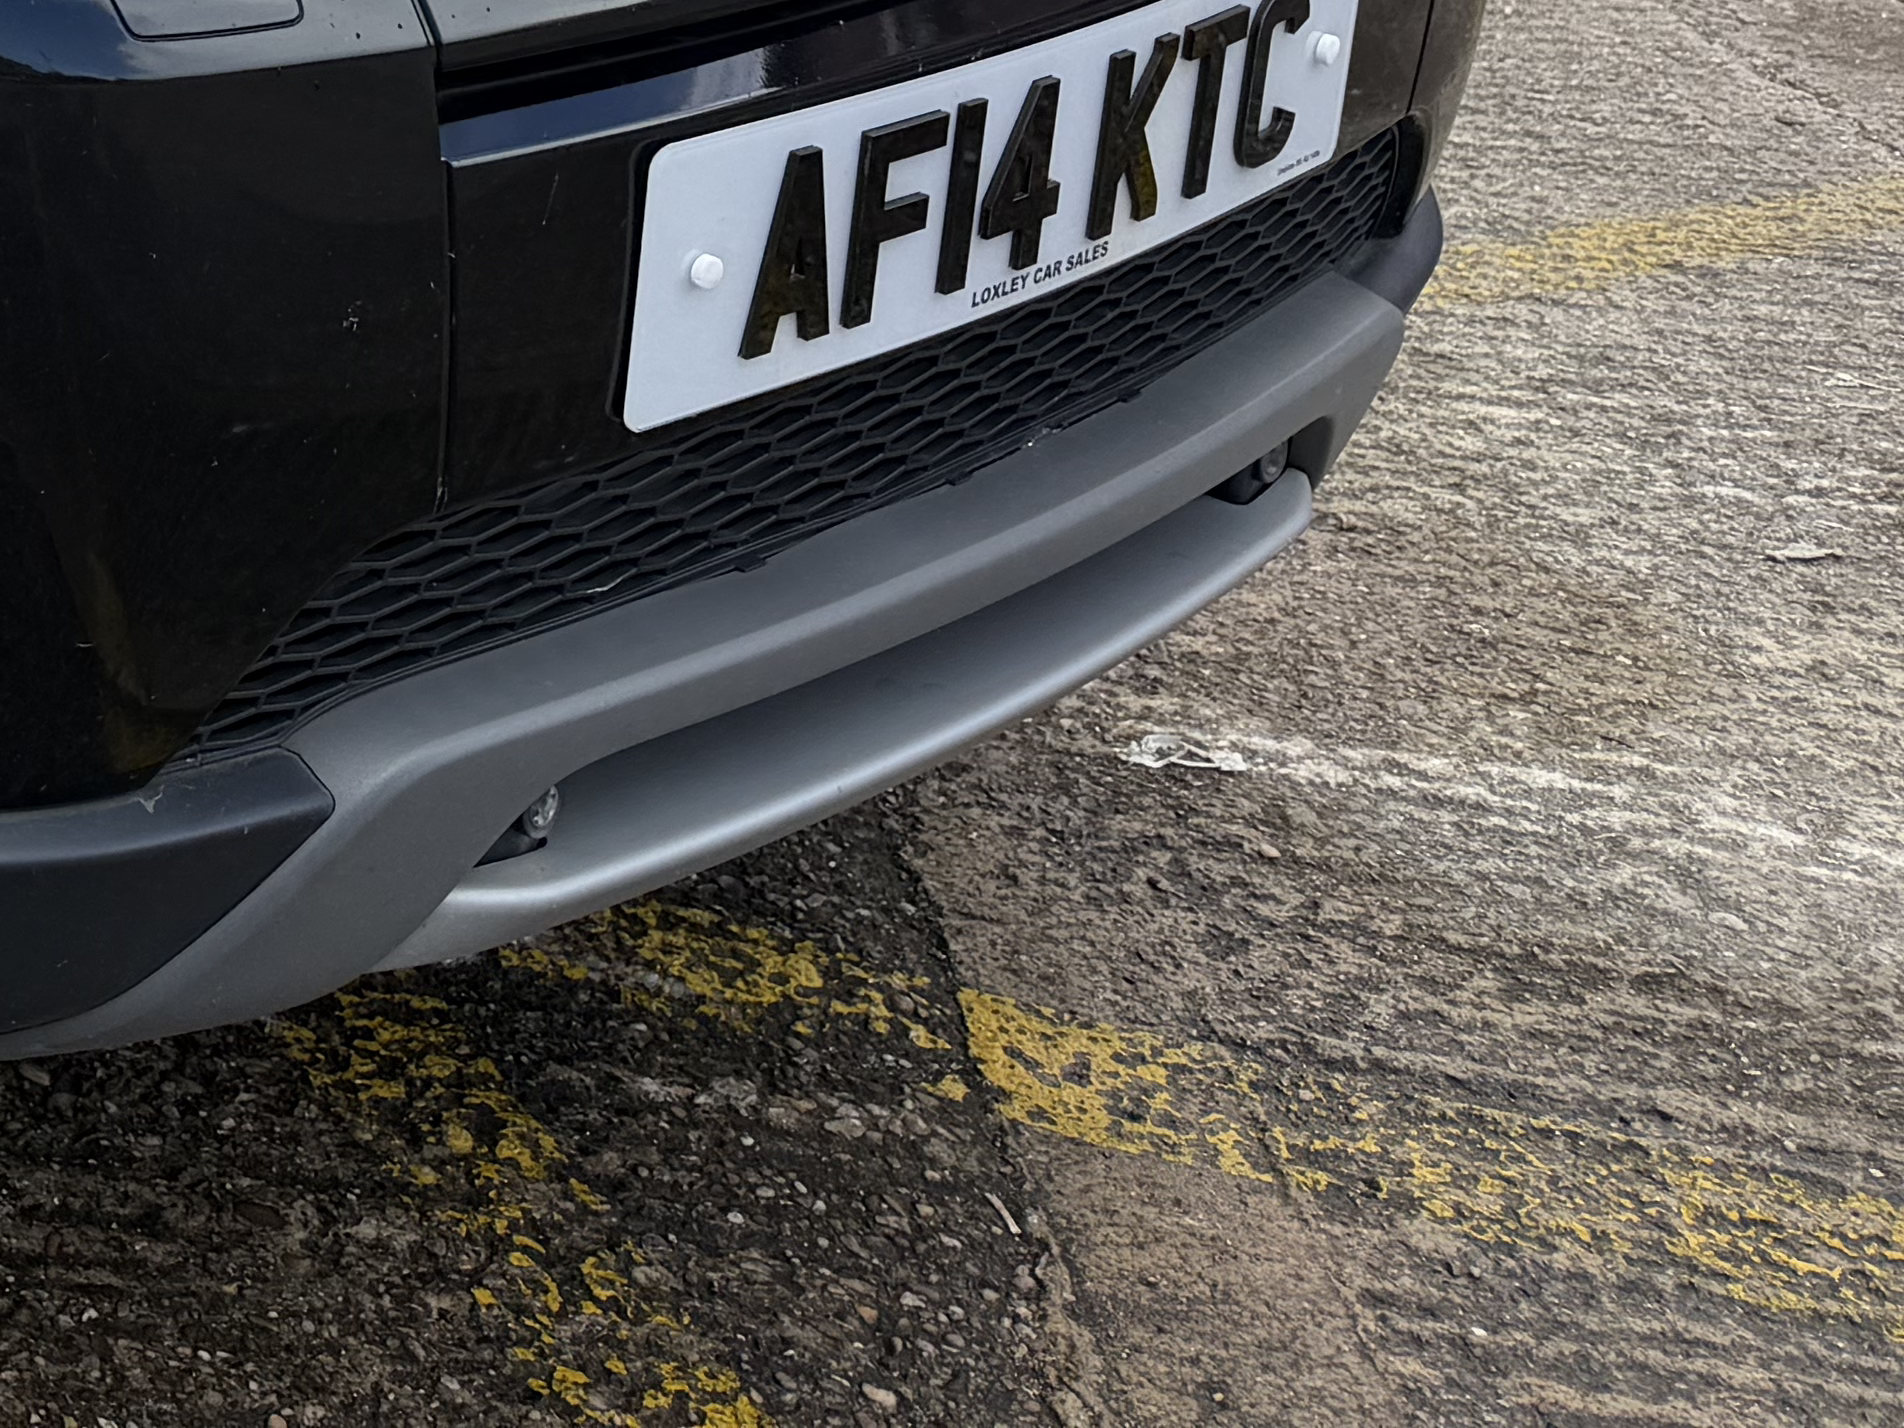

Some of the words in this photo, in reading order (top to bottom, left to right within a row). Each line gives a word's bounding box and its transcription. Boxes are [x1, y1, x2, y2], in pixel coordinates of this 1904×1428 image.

[737, 74, 1061, 361] AF14
[971, 271, 1031, 308] LOXLEY
[1033, 260, 1063, 285] CAR
[1065, 240, 1109, 272] SALES
